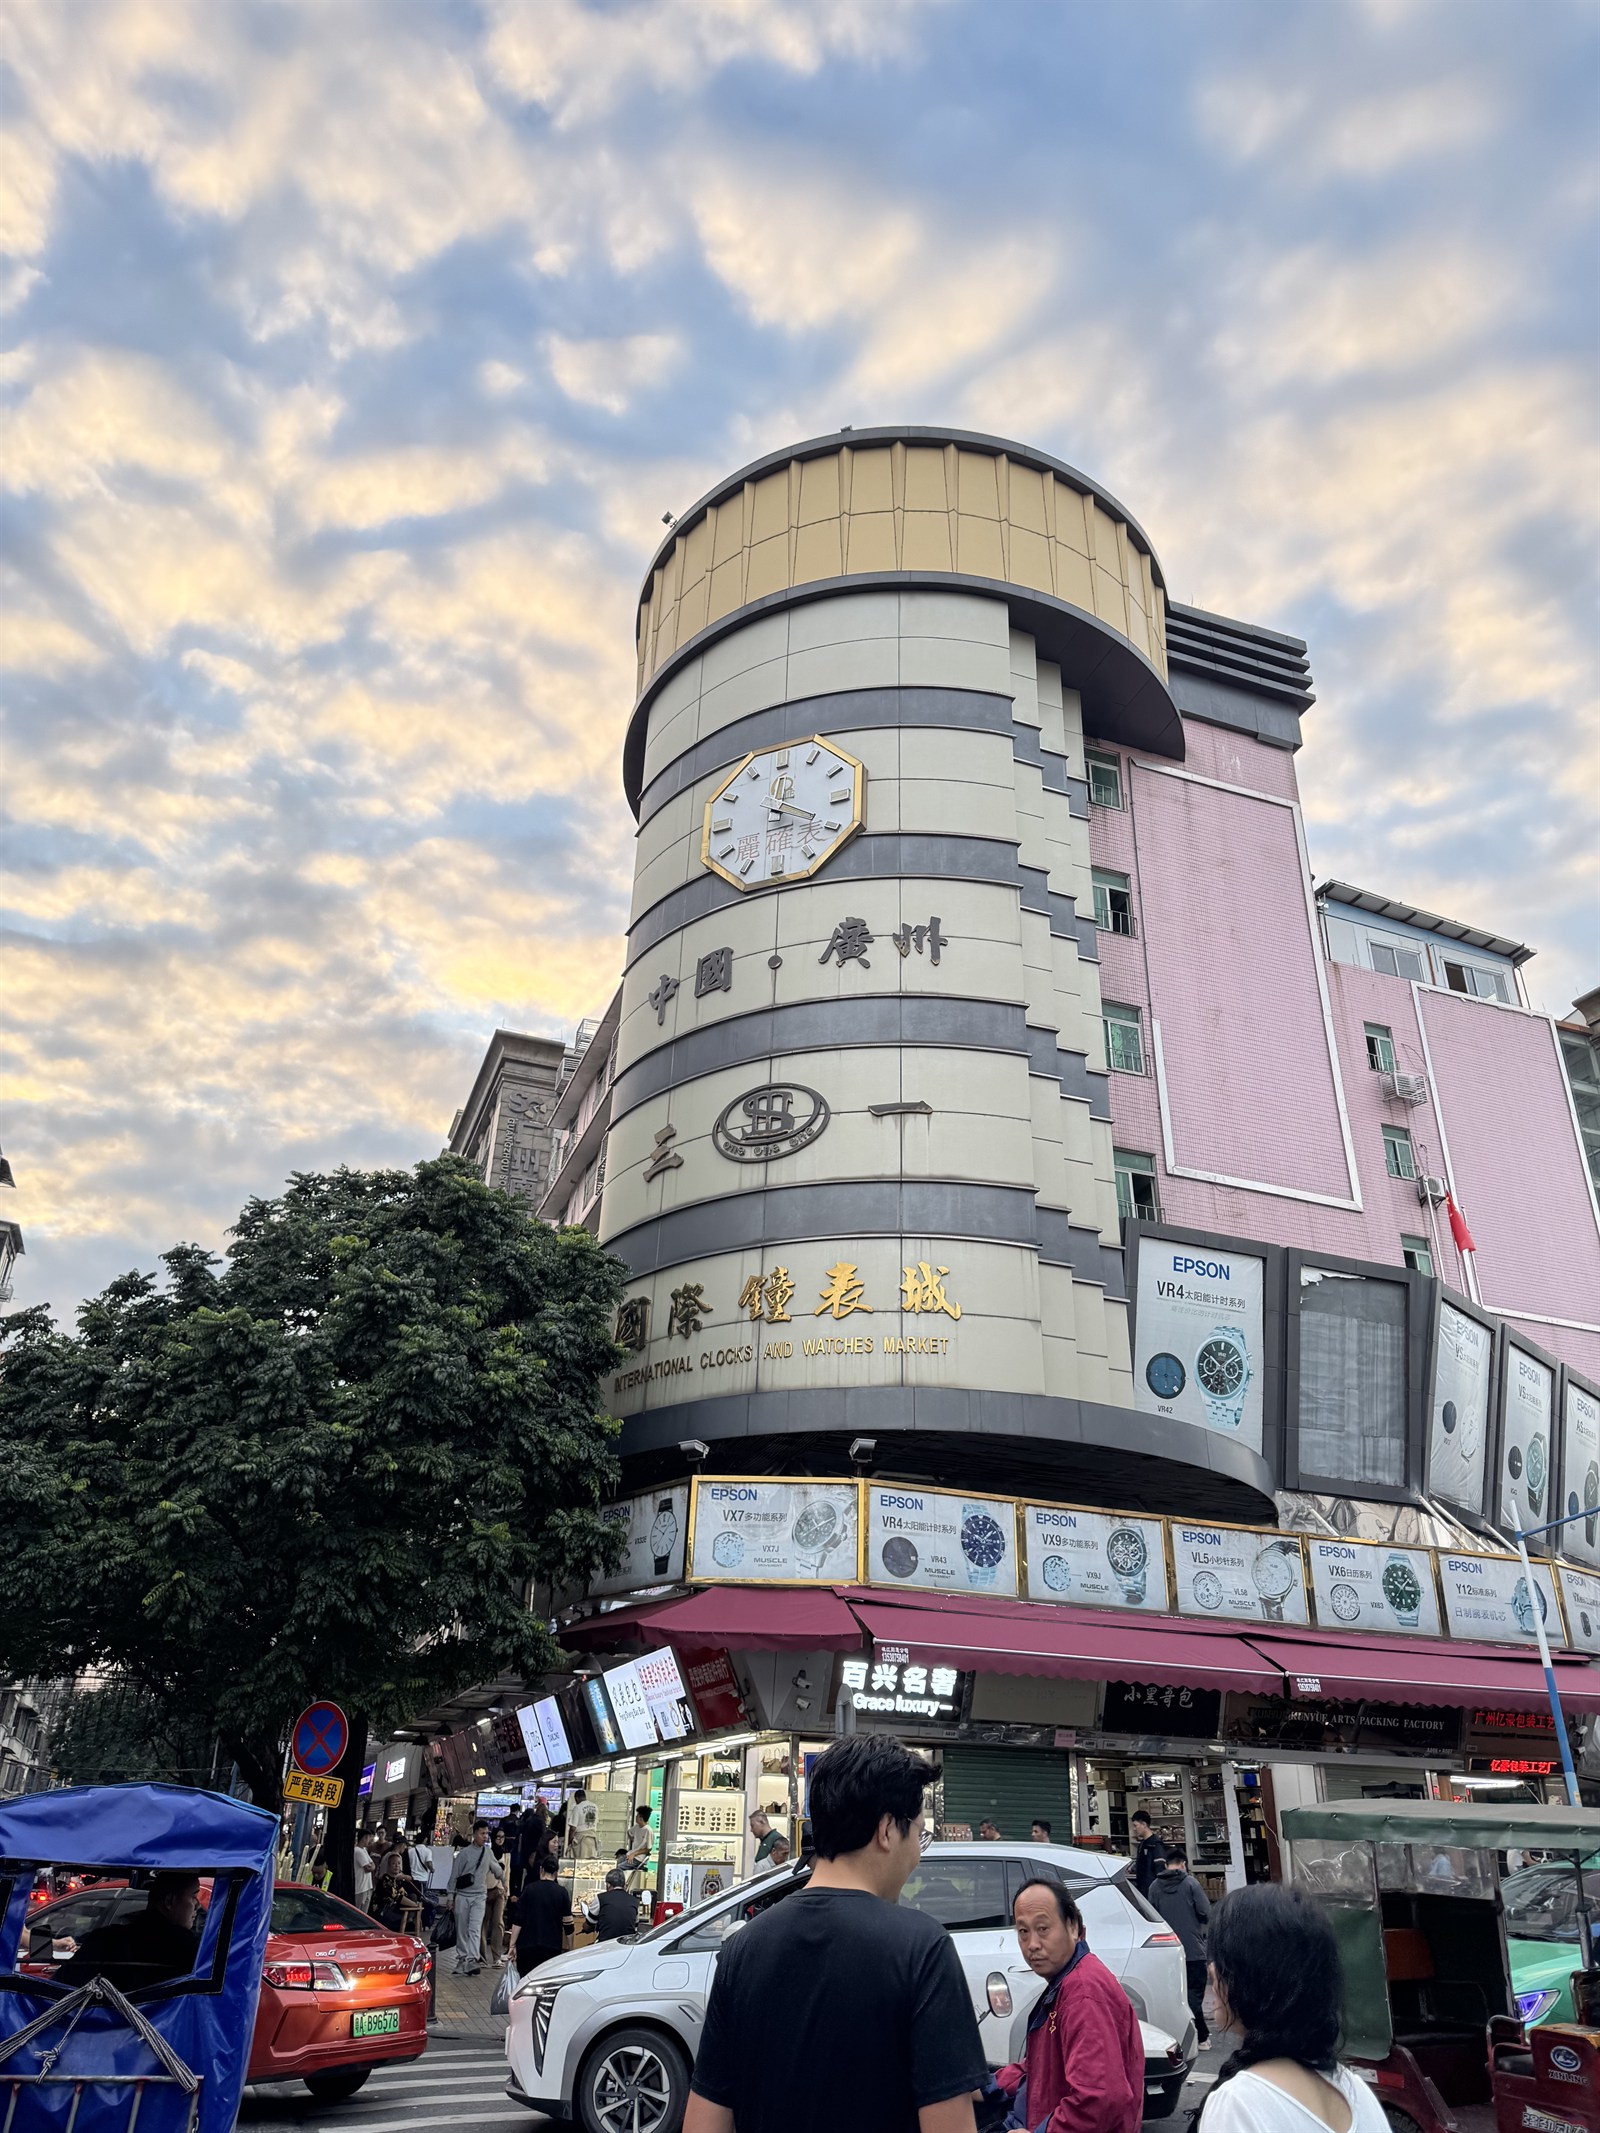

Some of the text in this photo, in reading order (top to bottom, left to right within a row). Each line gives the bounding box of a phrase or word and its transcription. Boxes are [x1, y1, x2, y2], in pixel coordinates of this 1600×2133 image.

[735, 820, 831, 863] 麗確表
[501, 1118, 515, 1171] GUANGZHOU
[723, 1126, 815, 1157] one one one
[1173, 1256, 1230, 1281] EPSON
[1457, 1320, 1479, 1347] EPSON
[614, 1336, 949, 1393] INTERNATIONAL CLOCKS AND WATCHES MARKET
[1520, 1361, 1541, 1386] EPSON
[1157, 1405, 1173, 1414] VR42
[1577, 1397, 1596, 1420] EPSON
[711, 1488, 757, 1501] EPSON
[880, 1494, 924, 1511] EPSON
[603, 1505, 631, 1522] EPSON
[1036, 1512, 1077, 1528] EPSON
[1182, 1531, 1221, 1546] EPSON
[762, 1545, 780, 1553] VX7J
[1319, 1545, 1356, 1559] EPSON
[930, 1555, 947, 1564] VR43
[1448, 1560, 1483, 1574] EPSON
[924, 1567, 956, 1576] MUSCLE
[1086, 1571, 1101, 1579] VX9J
[1080, 1582, 1110, 1591] MUSCLE
[1566, 1573, 1587, 1588] EPSON
[1228, 1599, 1257, 1607] MUSCLE
[853, 1693, 940, 1717] Grace luxury
[1124, 1686, 1194, 1708] 小黑哥包
[1331, 1714, 1356, 1724] ARTS
[1360, 1716, 1399, 1727] PACKING
[1404, 1719, 1445, 1730] FACTORY
[1490, 1759, 1557, 1774] 亿豪包装工艺厂
[288, 1776, 338, 1801] 严管路段
